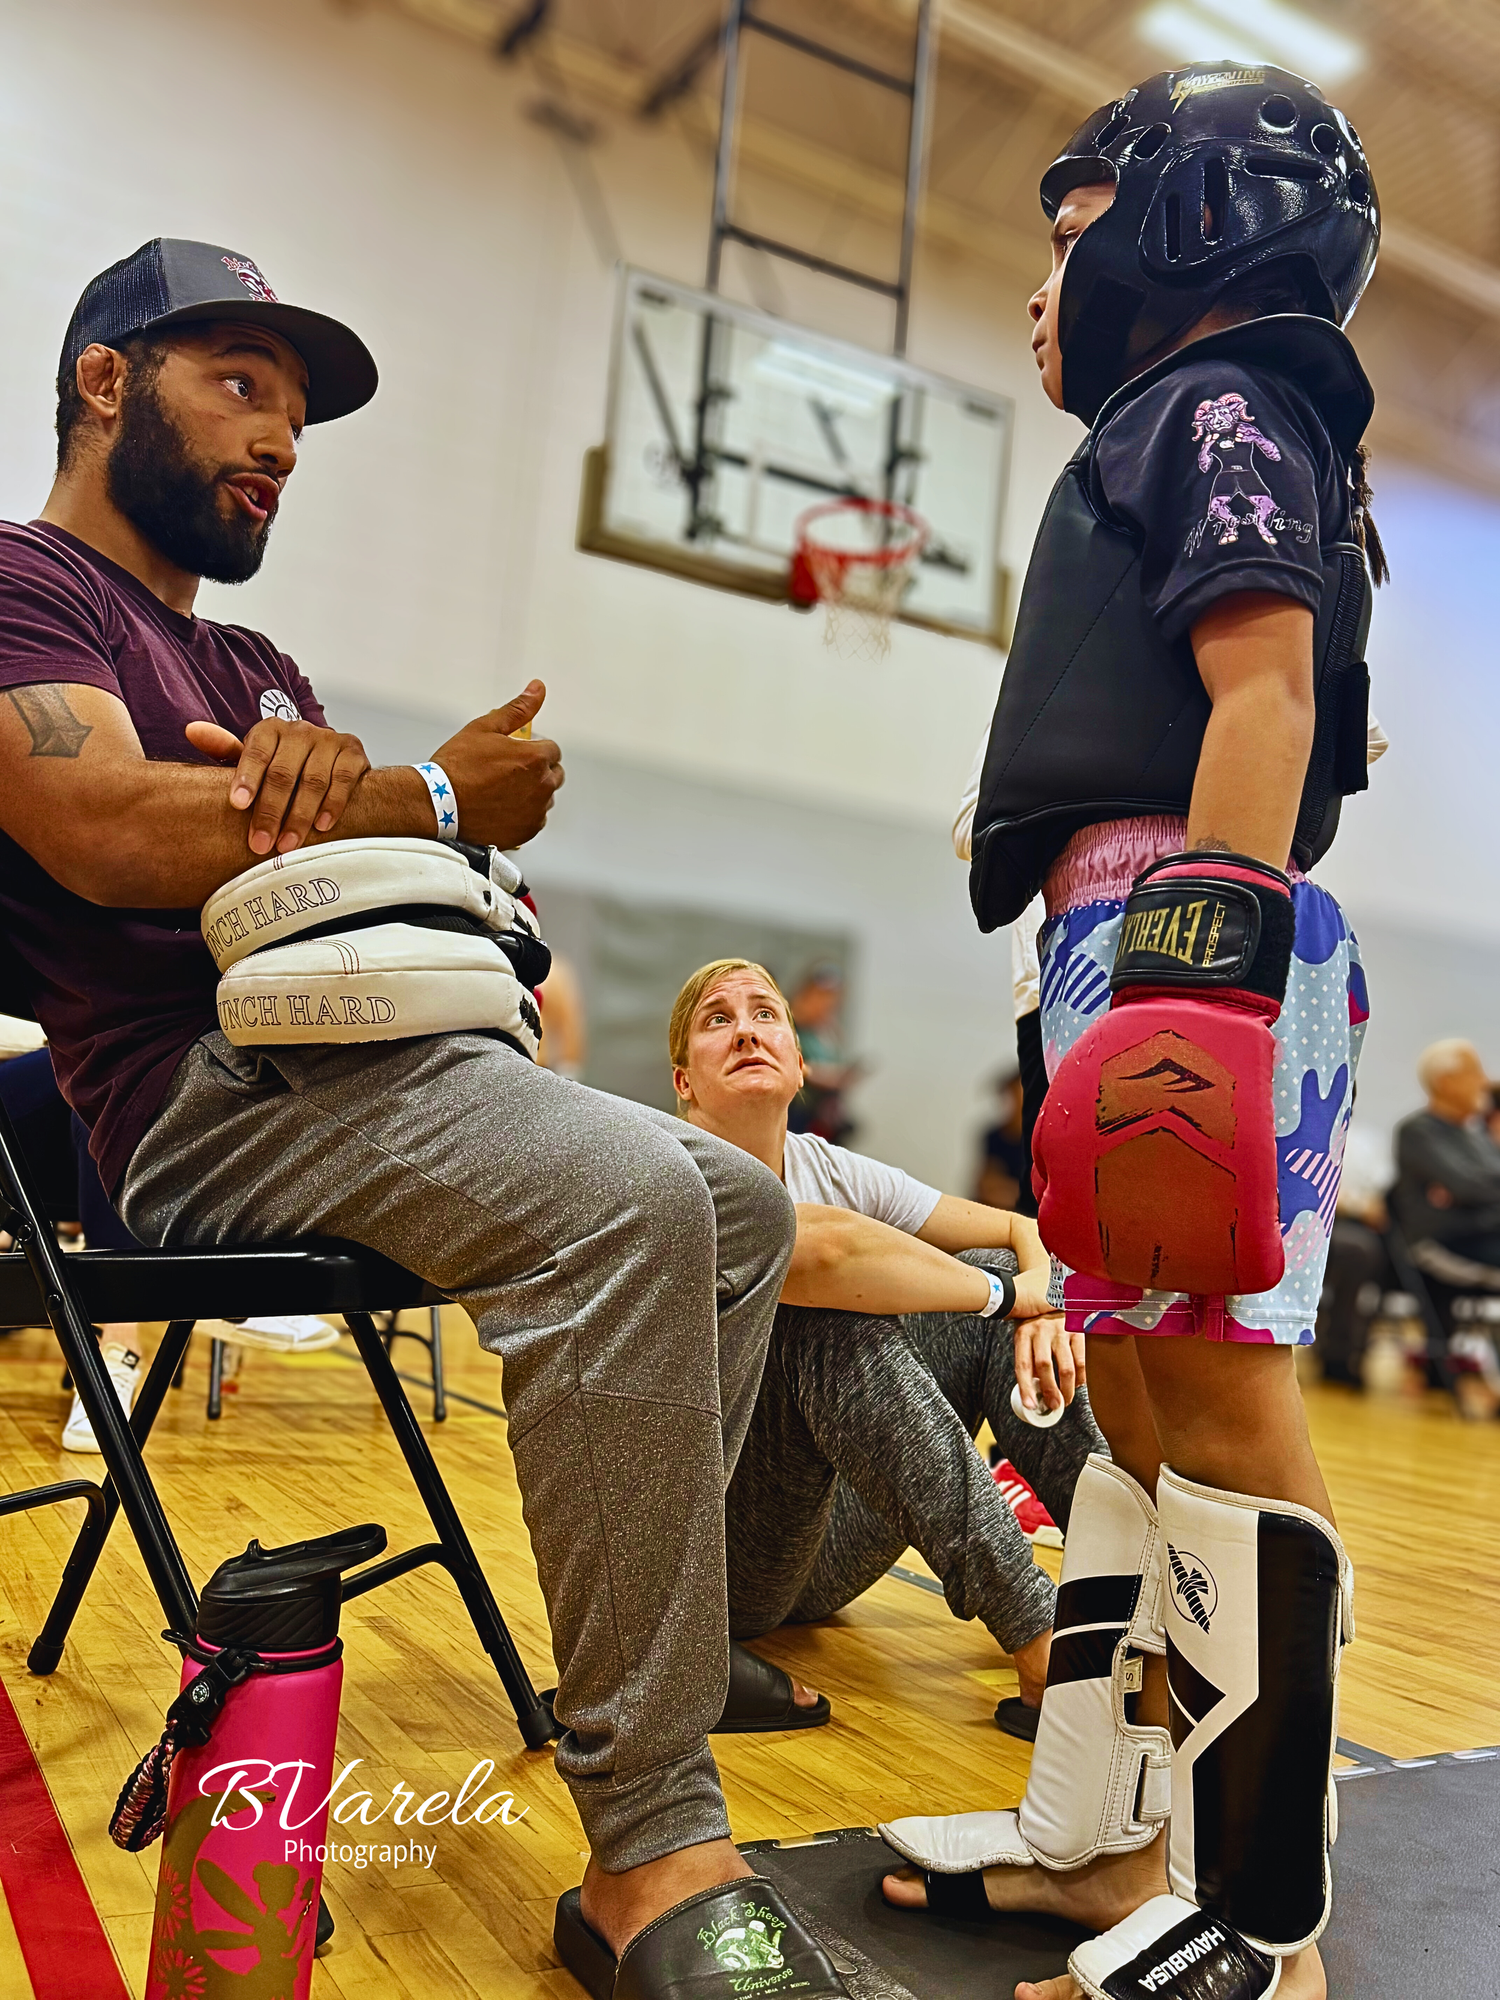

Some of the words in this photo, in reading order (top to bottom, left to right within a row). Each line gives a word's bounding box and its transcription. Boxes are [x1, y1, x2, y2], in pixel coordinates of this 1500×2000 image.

[206, 907, 249, 964] NCH
[244, 877, 341, 930] HARD
[1115, 899, 1208, 966] EVERLA
[1201, 901, 1226, 968] PROSPECT
[286, 995, 396, 1026] HARD
[1125, 1672, 1134, 1682] S
[697, 1905, 741, 1951] Black
[741, 1901, 788, 1929] Sheep
[729, 1967, 794, 1992] Universe
[1137, 1926, 1226, 1993] HAYABUSA
